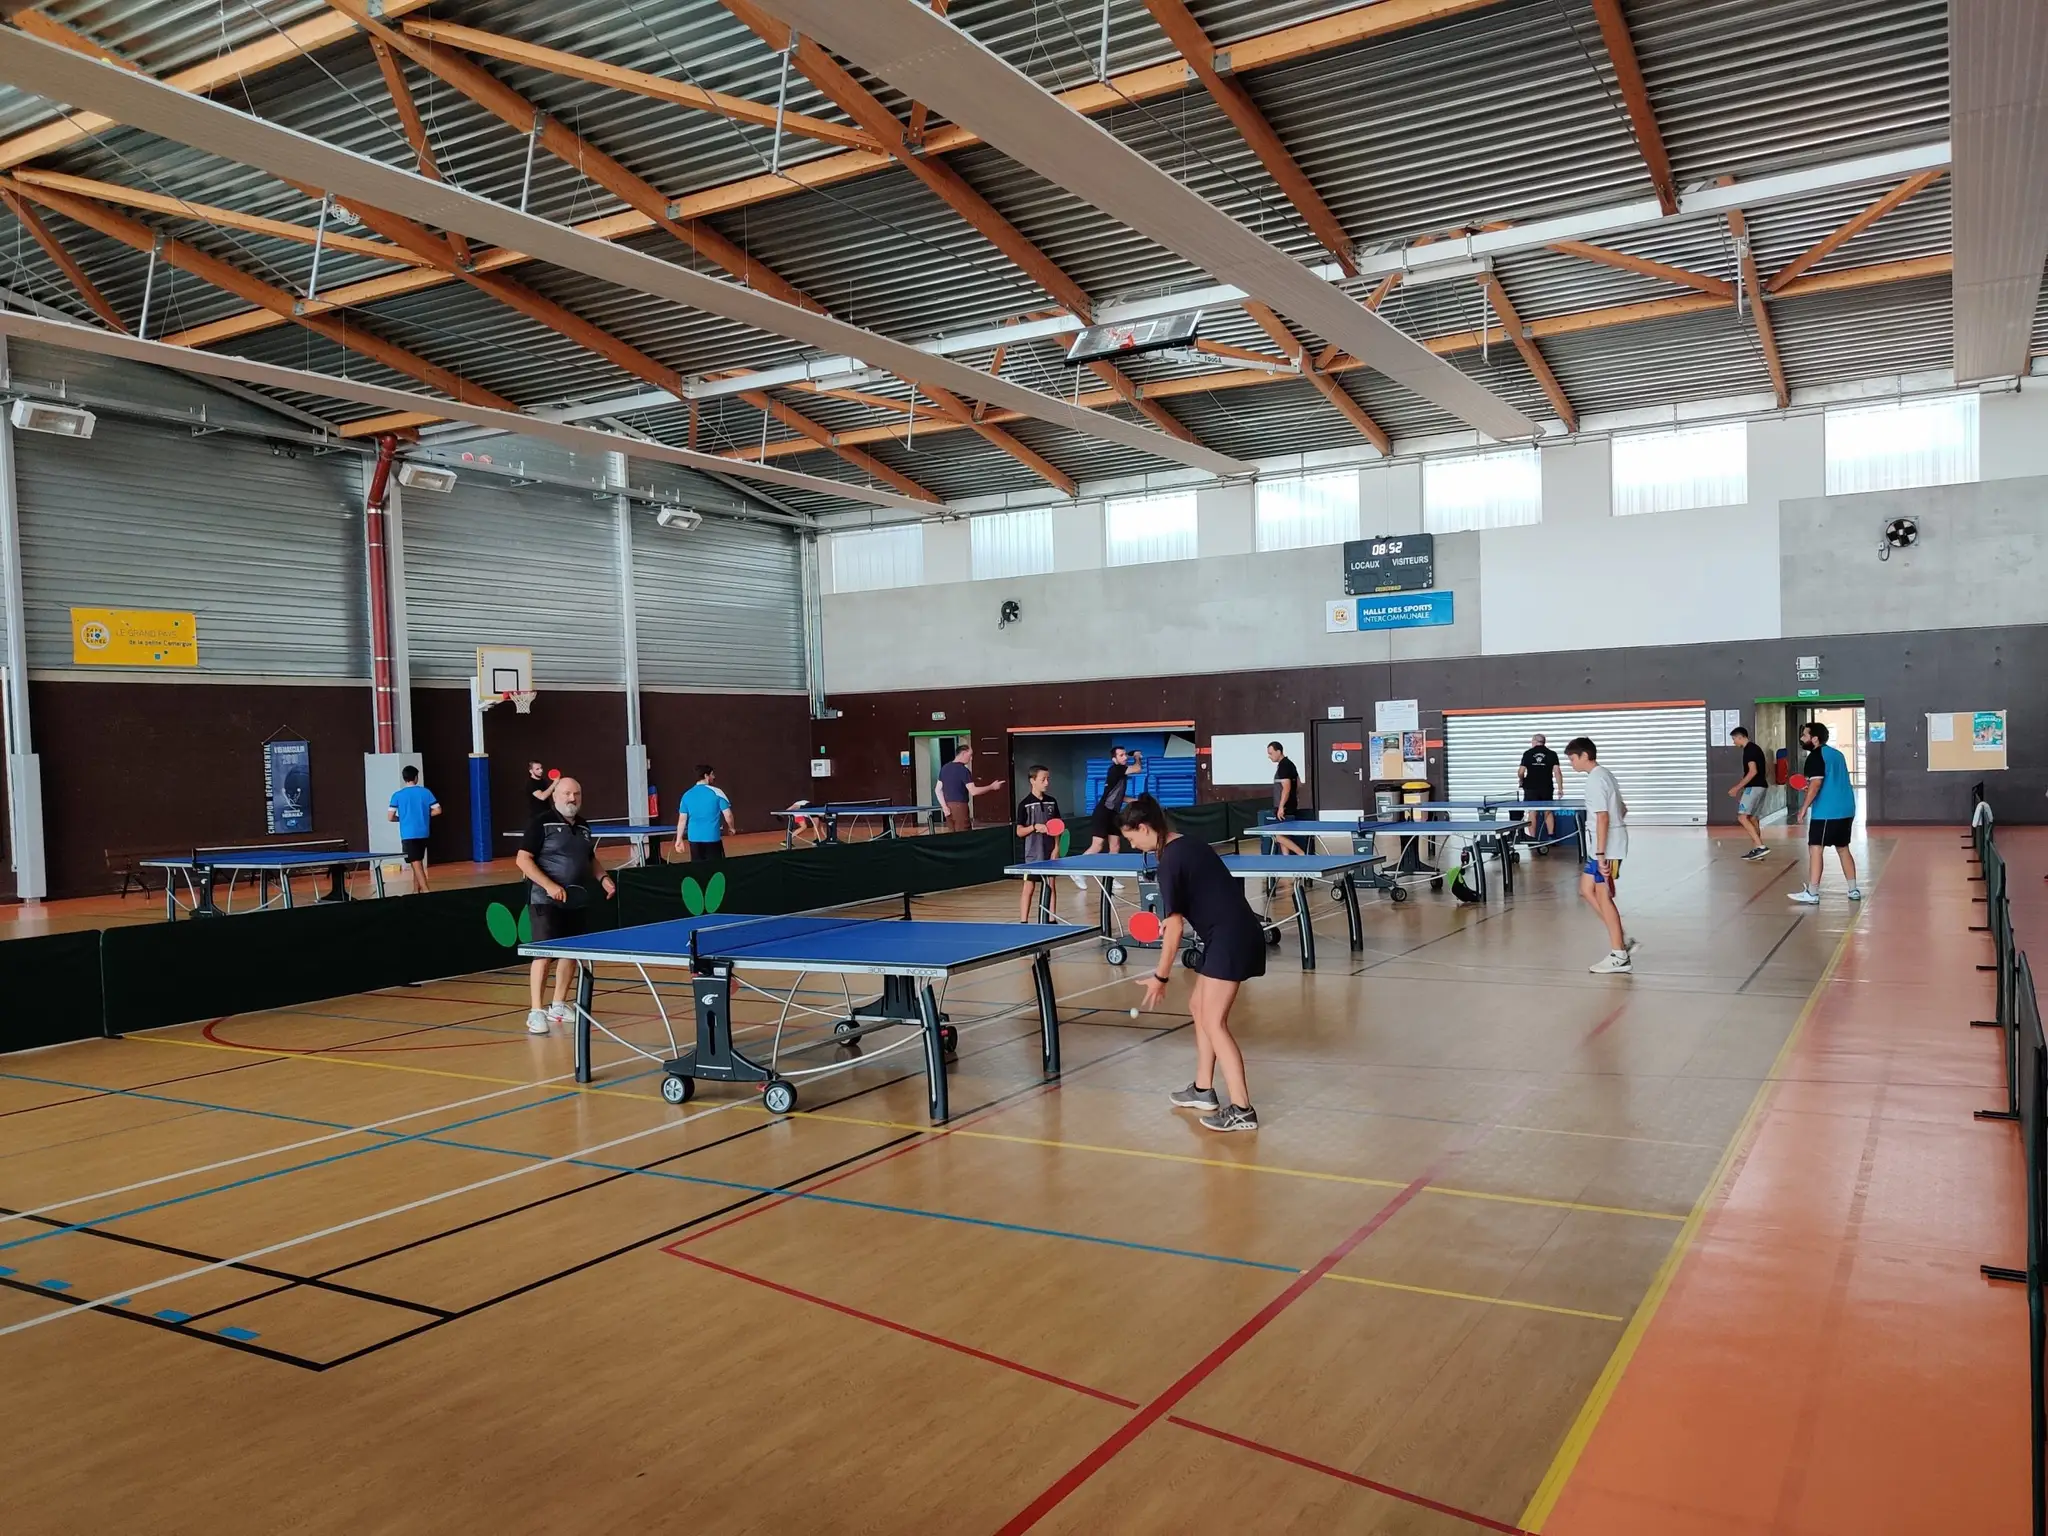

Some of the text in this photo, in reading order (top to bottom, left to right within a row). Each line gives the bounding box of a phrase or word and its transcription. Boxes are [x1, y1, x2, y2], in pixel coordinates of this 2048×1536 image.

[1350, 556, 1429, 570] LOCAUX VISITEURS
[1363, 604, 1432, 615] HALLE DES SPORTS
[1363, 611, 1430, 623] INTERCOMMUNALE
[266, 800, 275, 834] CHAMPION
